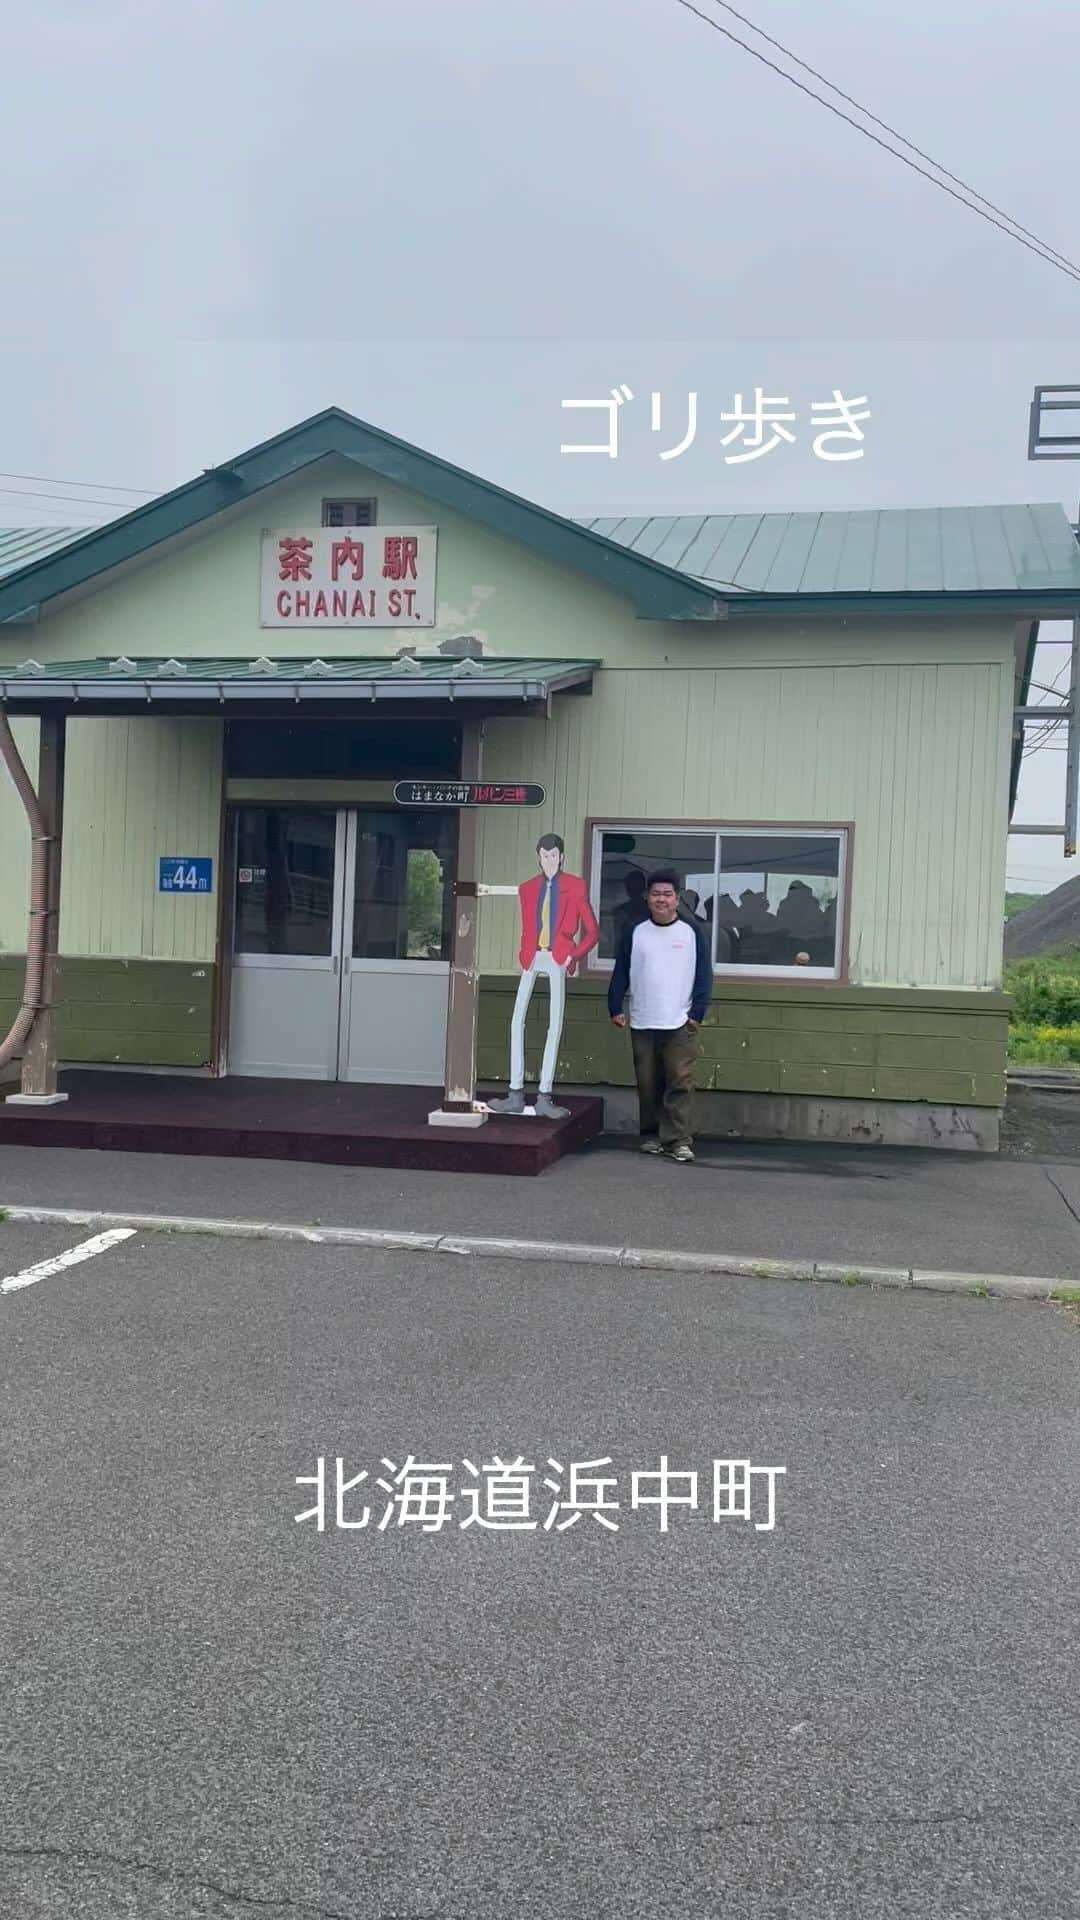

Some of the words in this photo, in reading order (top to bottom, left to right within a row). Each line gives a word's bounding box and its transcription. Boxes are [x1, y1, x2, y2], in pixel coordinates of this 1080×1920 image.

[278, 536, 418, 581] 茶内駅
[276, 589, 376, 617] CHANAI
[411, 791, 469, 803] はまなか町
[472, 786, 529, 803] ルパン三
